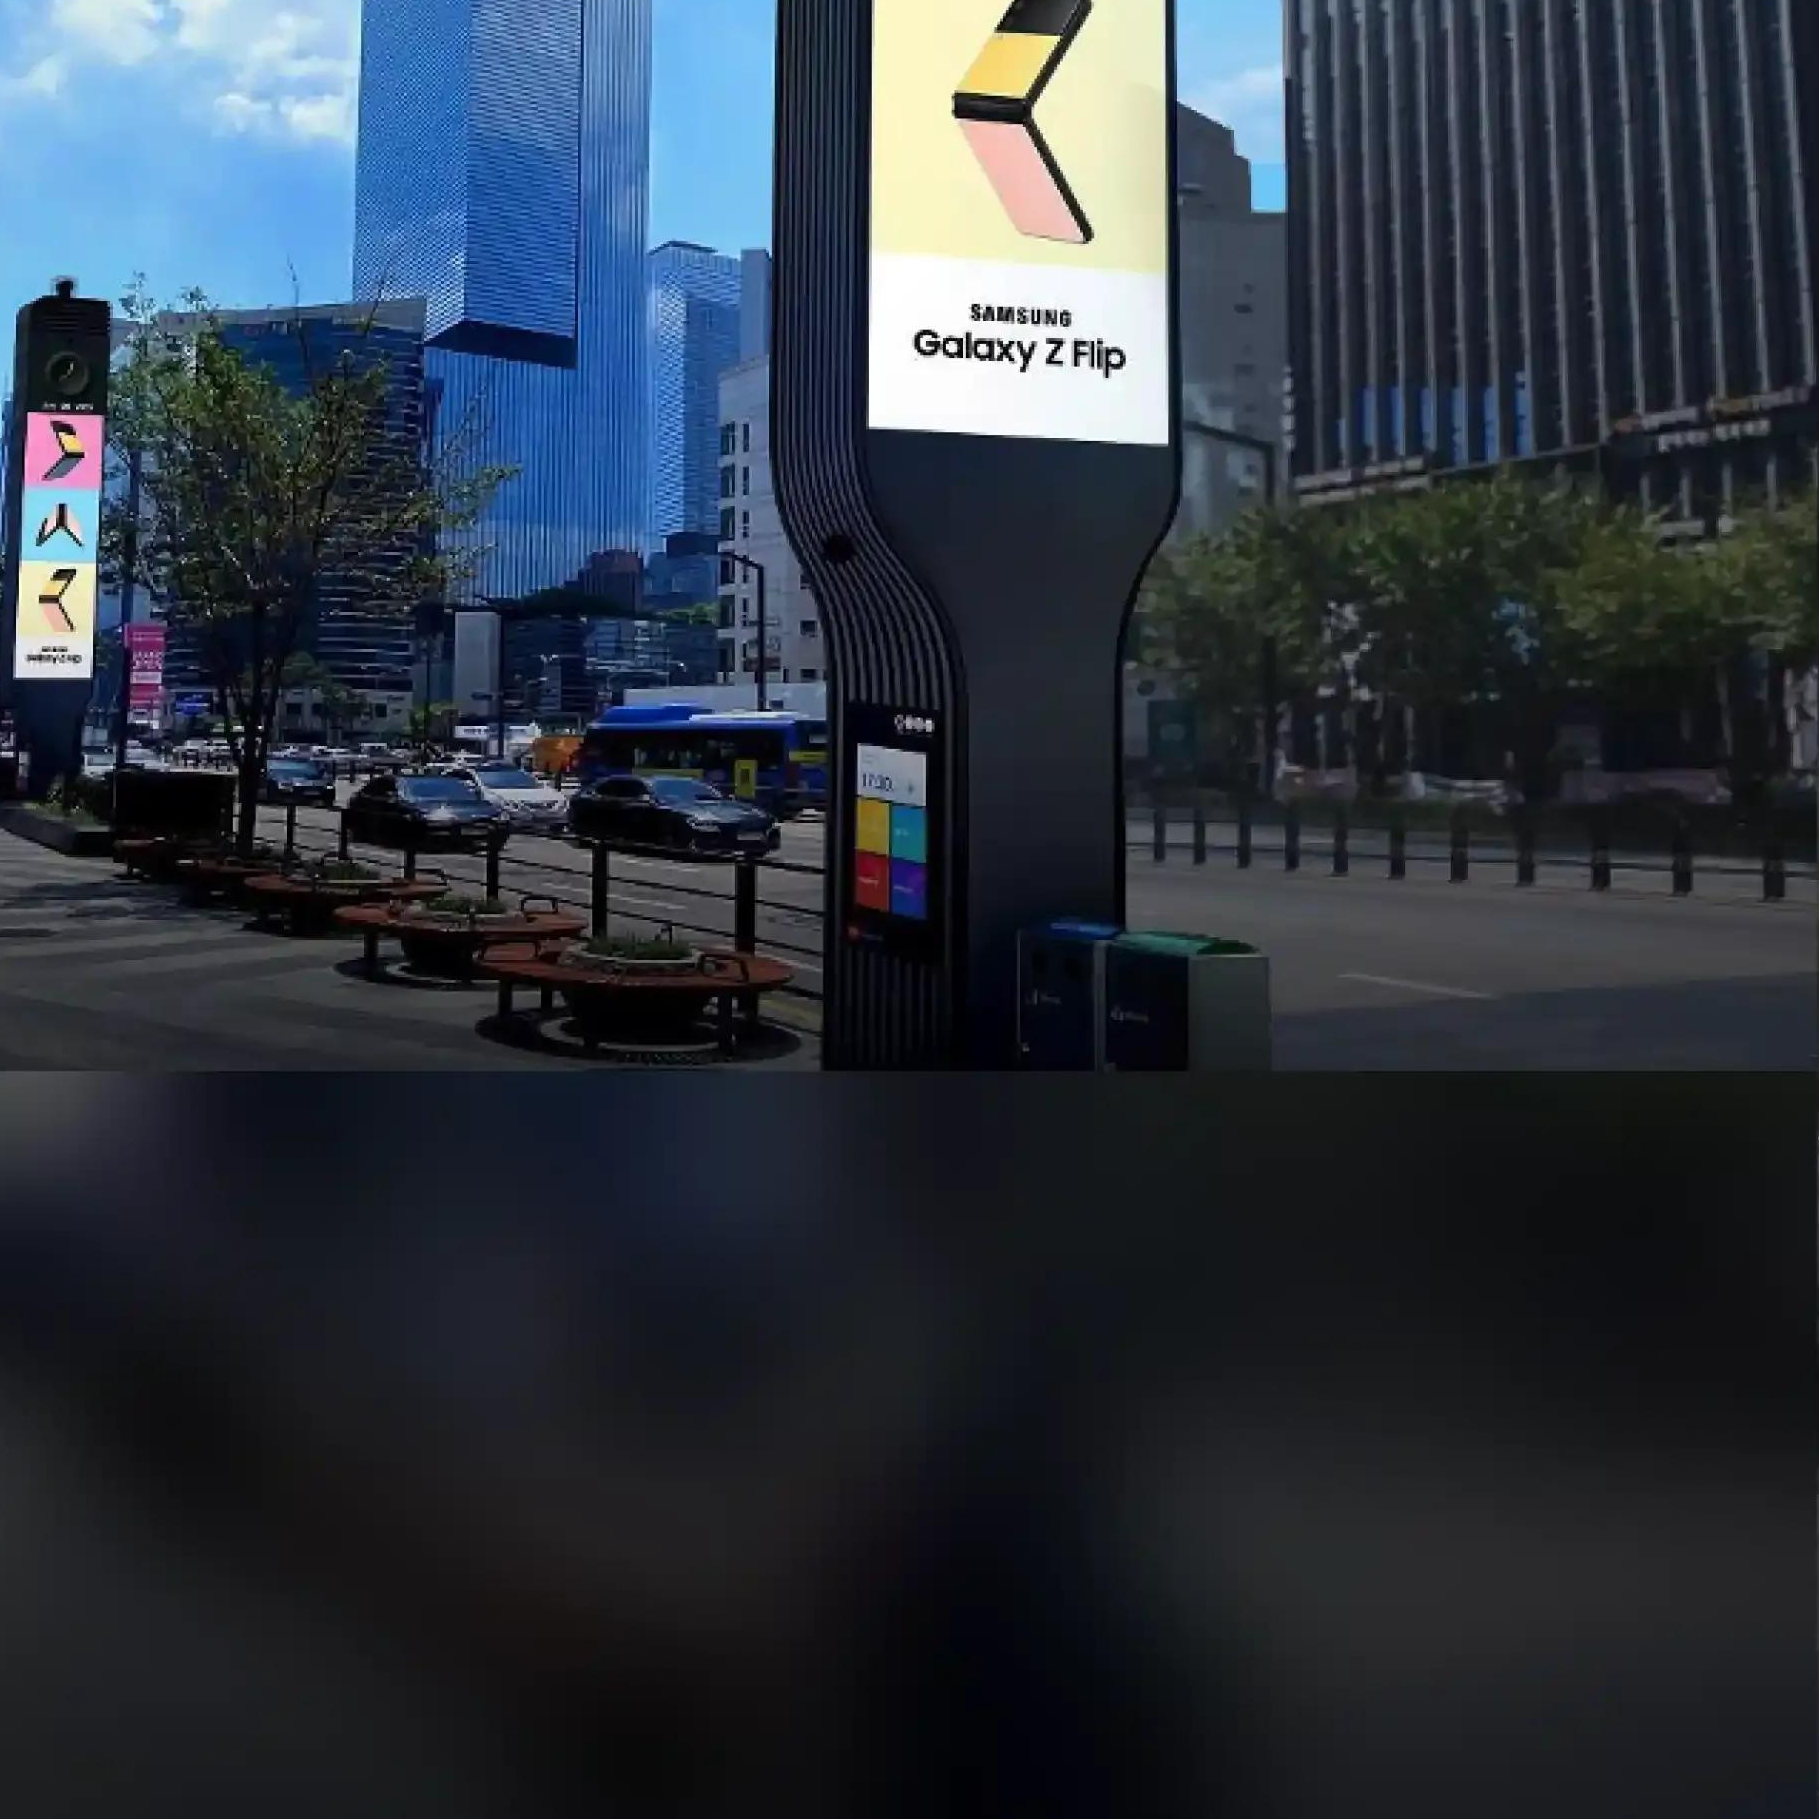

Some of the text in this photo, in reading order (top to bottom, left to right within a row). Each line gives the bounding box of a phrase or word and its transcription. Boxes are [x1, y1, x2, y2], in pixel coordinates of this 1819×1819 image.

[970, 303, 1073, 328] SAMSUNG
[913, 329, 1127, 379] Galaxy Z Flip
